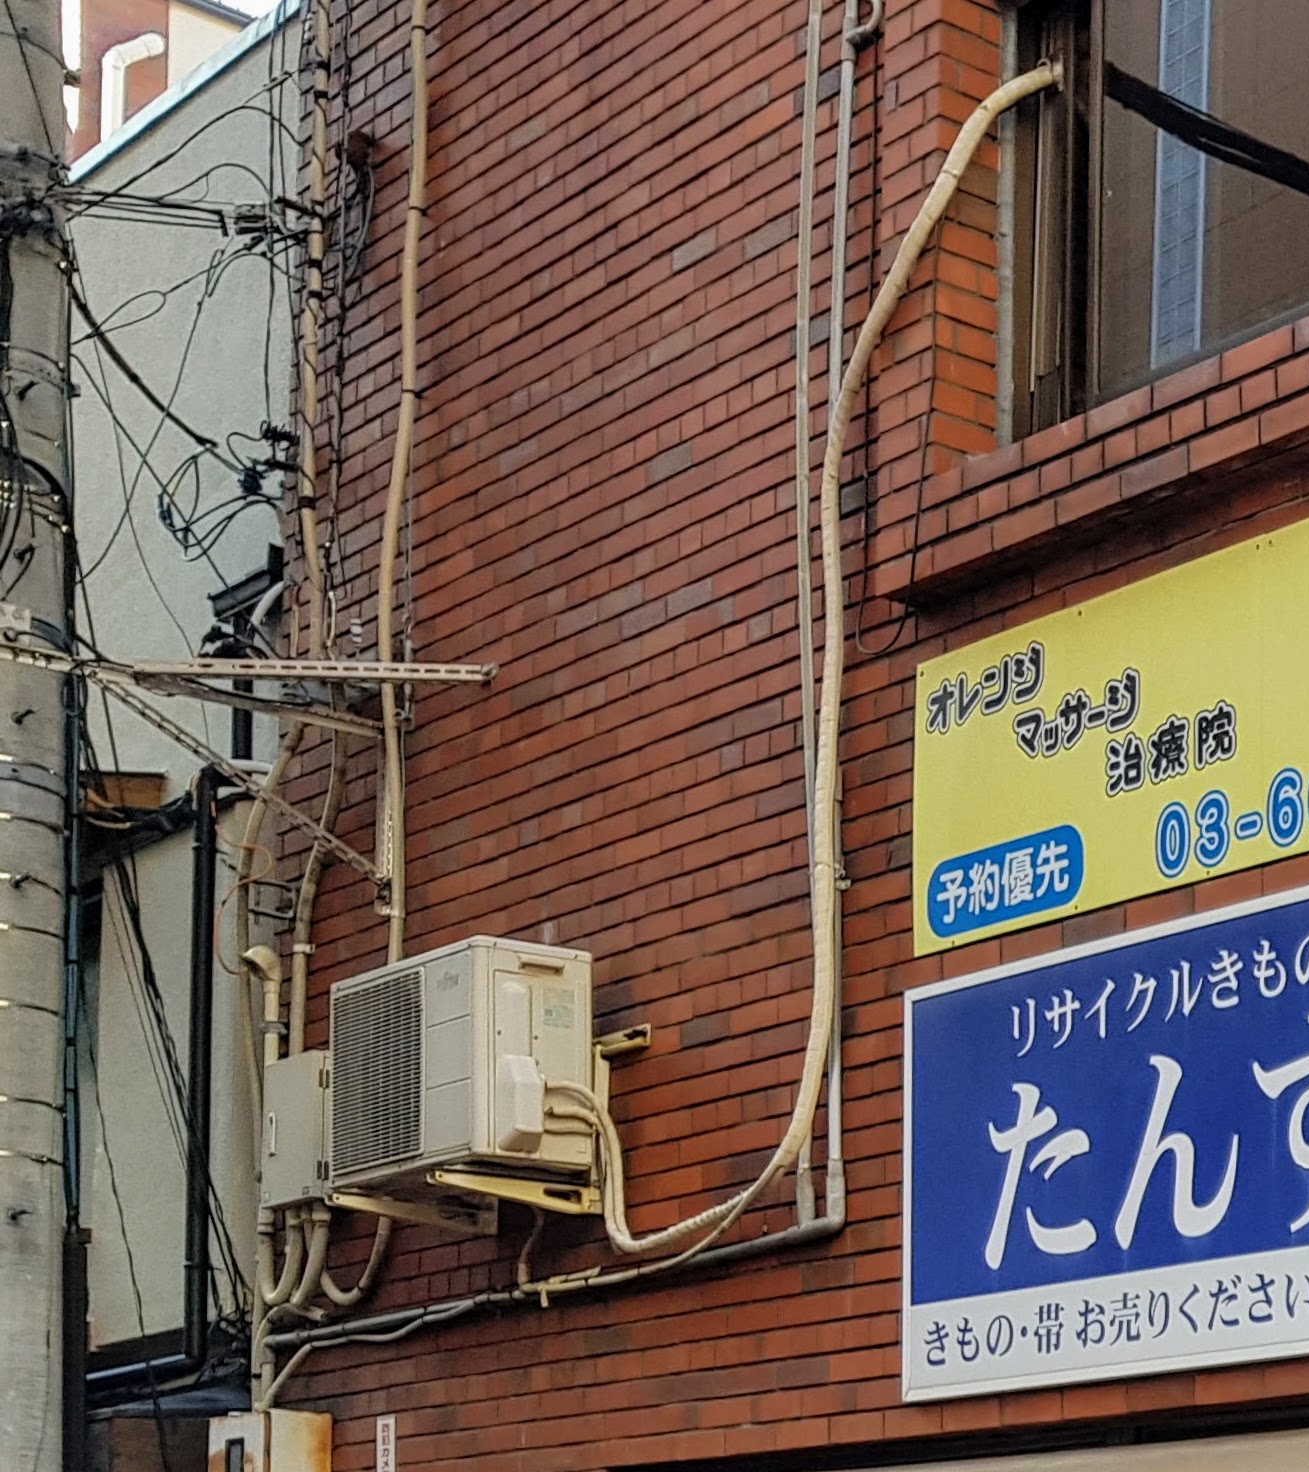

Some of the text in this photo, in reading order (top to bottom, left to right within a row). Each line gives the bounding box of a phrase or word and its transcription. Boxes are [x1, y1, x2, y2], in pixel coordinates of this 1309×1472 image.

[926, 641, 1044, 734] オレンジ
[1013, 668, 1141, 758] マッサージ
[1104, 700, 1238, 796] 治療院
[936, 840, 1073, 926] 予約優先
